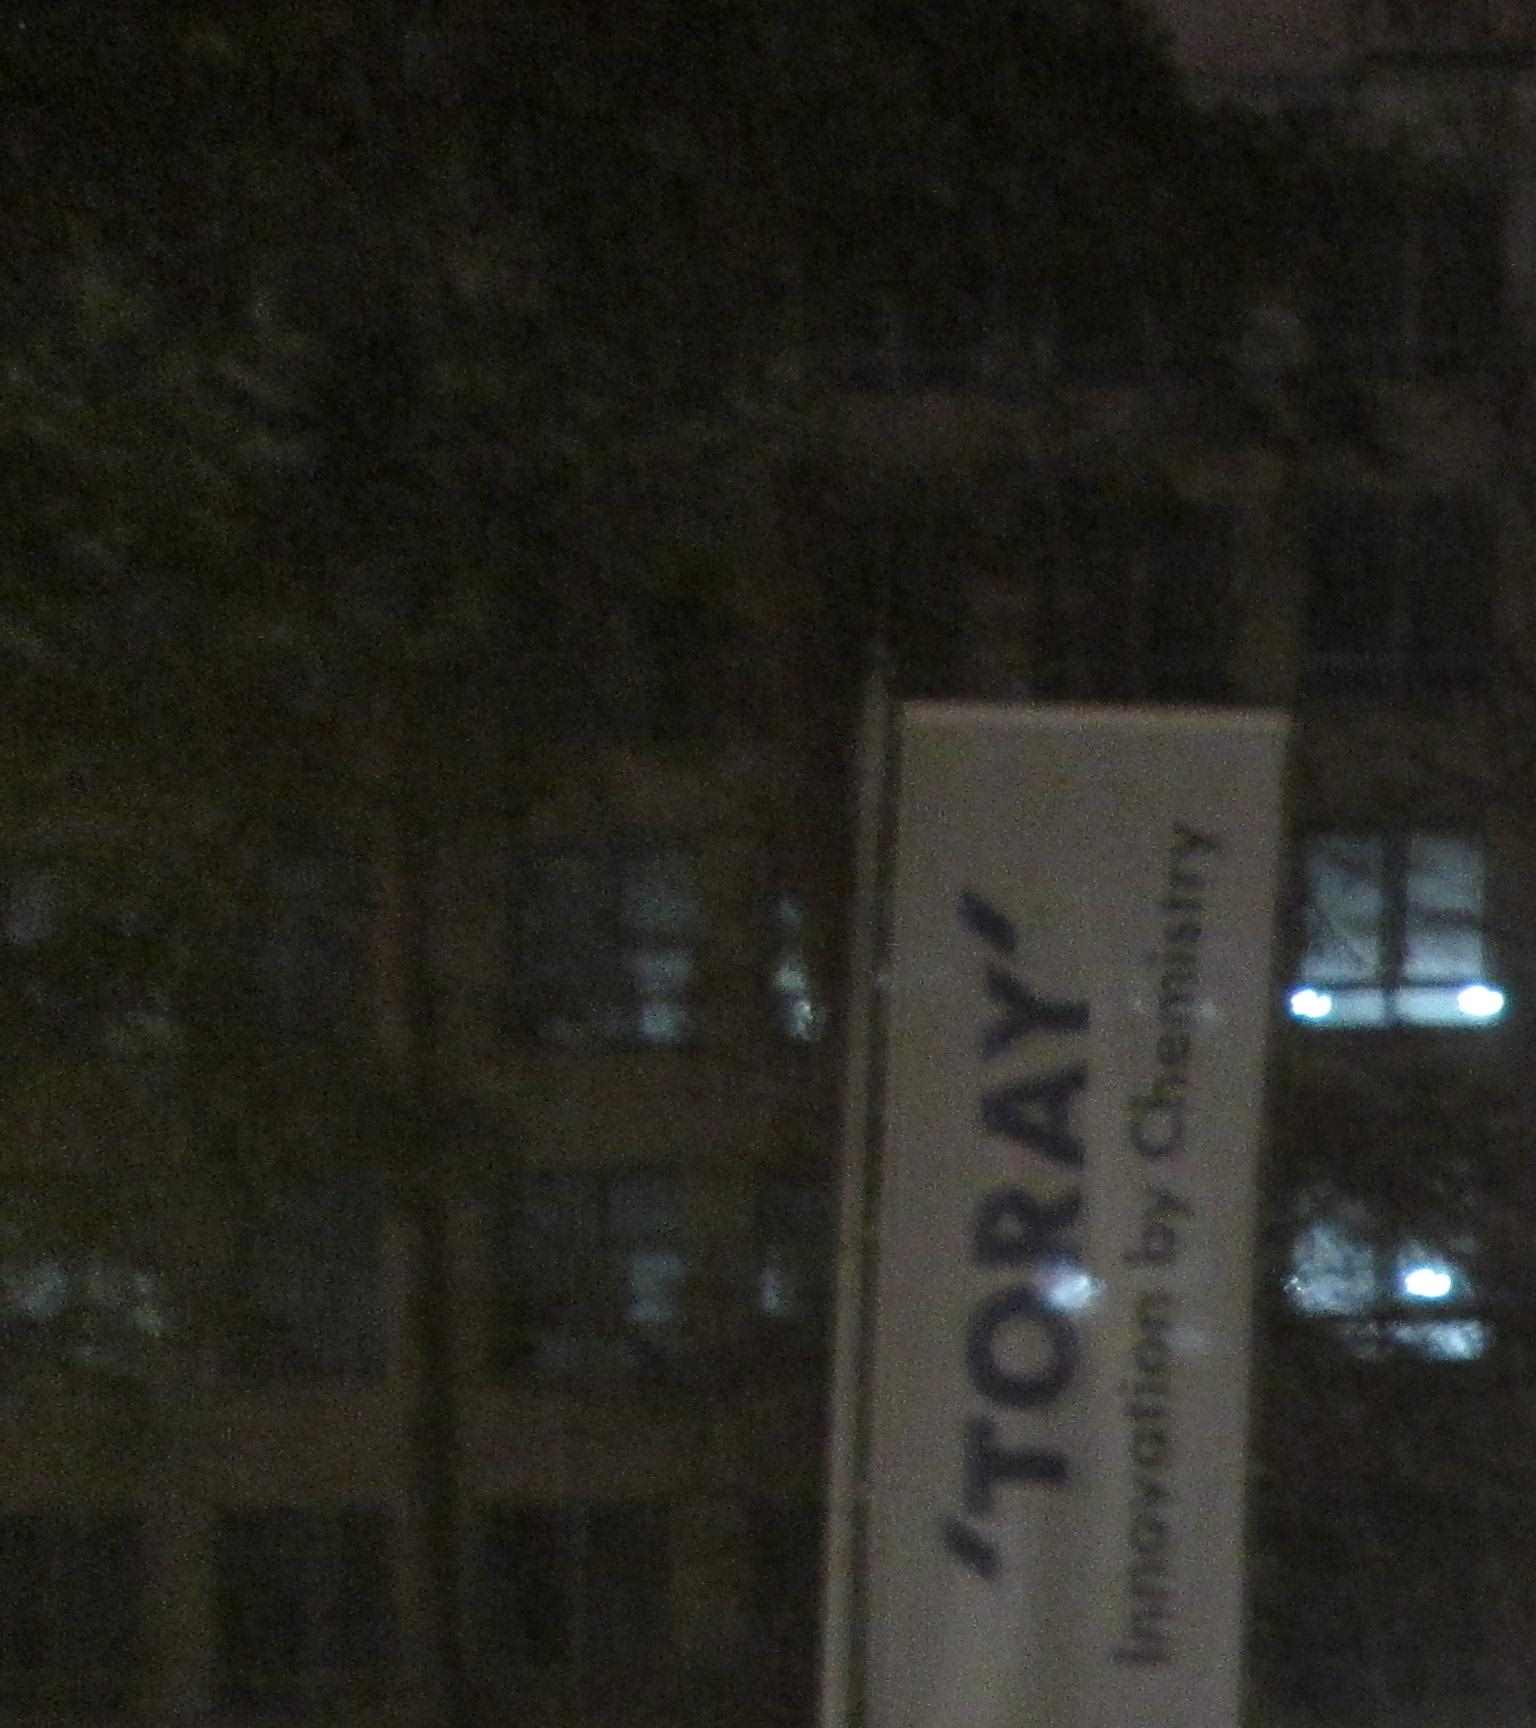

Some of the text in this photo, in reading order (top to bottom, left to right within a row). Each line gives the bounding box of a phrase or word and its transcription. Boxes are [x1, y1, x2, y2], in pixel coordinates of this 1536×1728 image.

[1105, 822, 1222, 1672] Innovation by Chemistry
